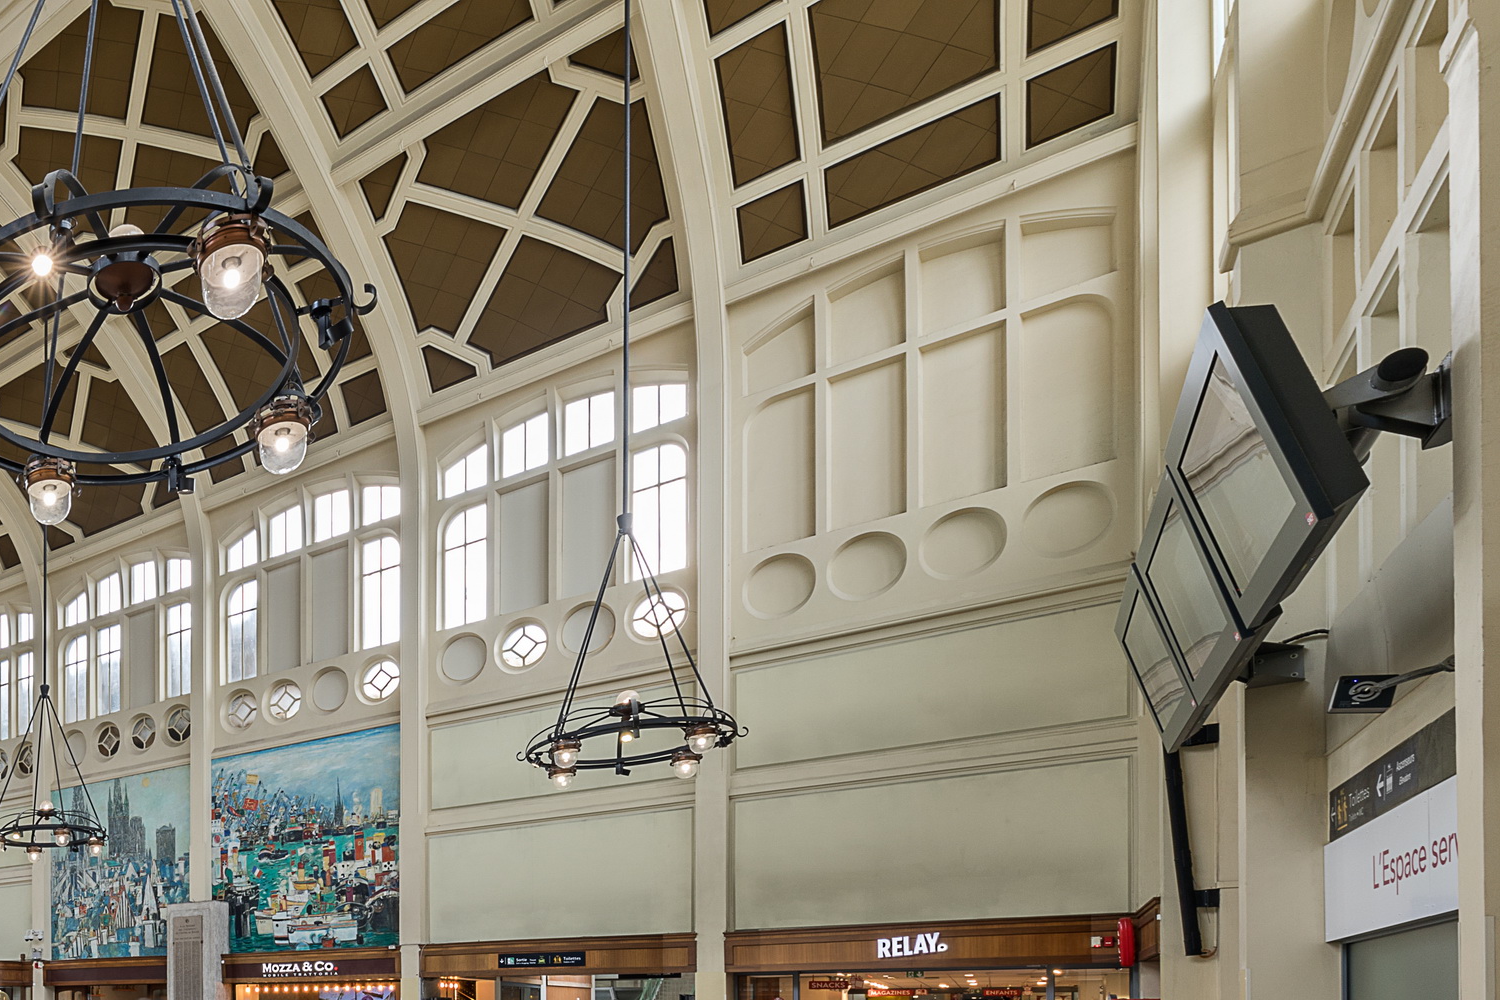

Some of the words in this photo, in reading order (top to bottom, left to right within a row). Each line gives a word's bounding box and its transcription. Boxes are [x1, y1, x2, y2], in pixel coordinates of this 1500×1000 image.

[1348, 786, 1370, 807] Toilettes
[1372, 845, 1427, 896] L'Espace
[302, 961, 312, 972] &
[811, 981, 846, 989] SNACKS
